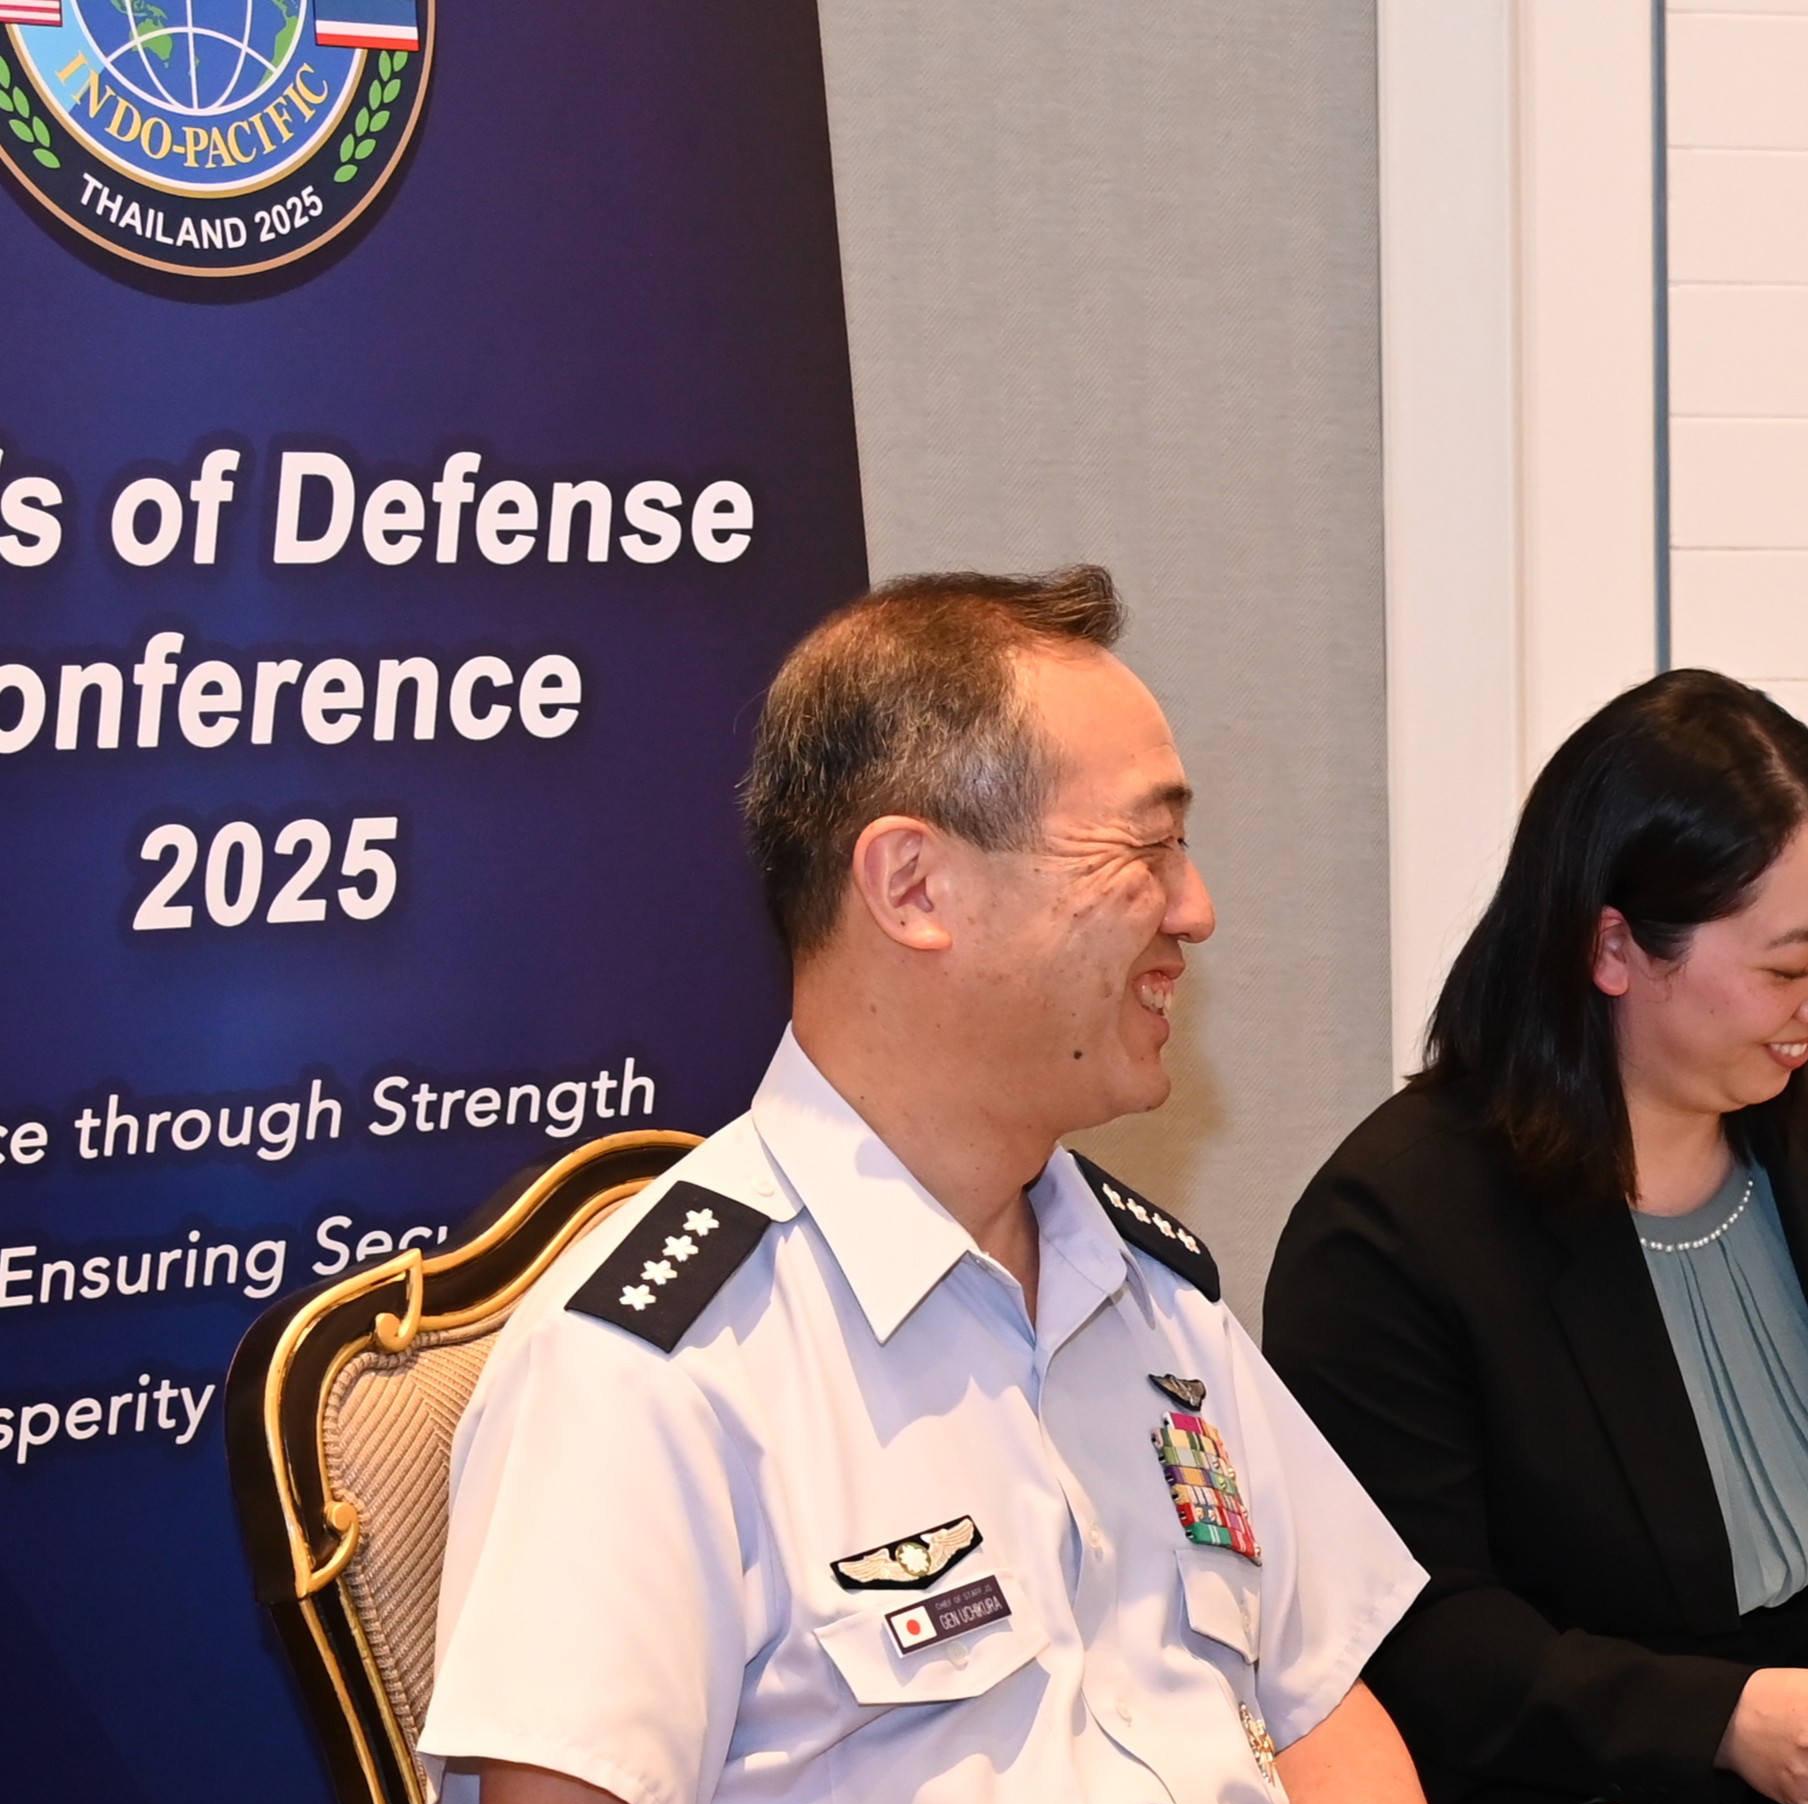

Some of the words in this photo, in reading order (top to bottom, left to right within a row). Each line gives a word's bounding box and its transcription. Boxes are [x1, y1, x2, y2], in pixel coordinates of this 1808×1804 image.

[55, 51, 328, 169] INDO-PACIFIC
[80, 172, 247, 249] THAILAND
[254, 185, 323, 242] 2025
[111, 448, 241, 567] of
[273, 451, 754, 566] Defense
[0, 631, 582, 754] onference
[132, 816, 399, 931] 2025
[74, 1089, 342, 1161] through
[368, 1057, 655, 1137] Strength
[0, 1229, 287, 1308] Ensuring
[0, 1373, 216, 1465] sperity
